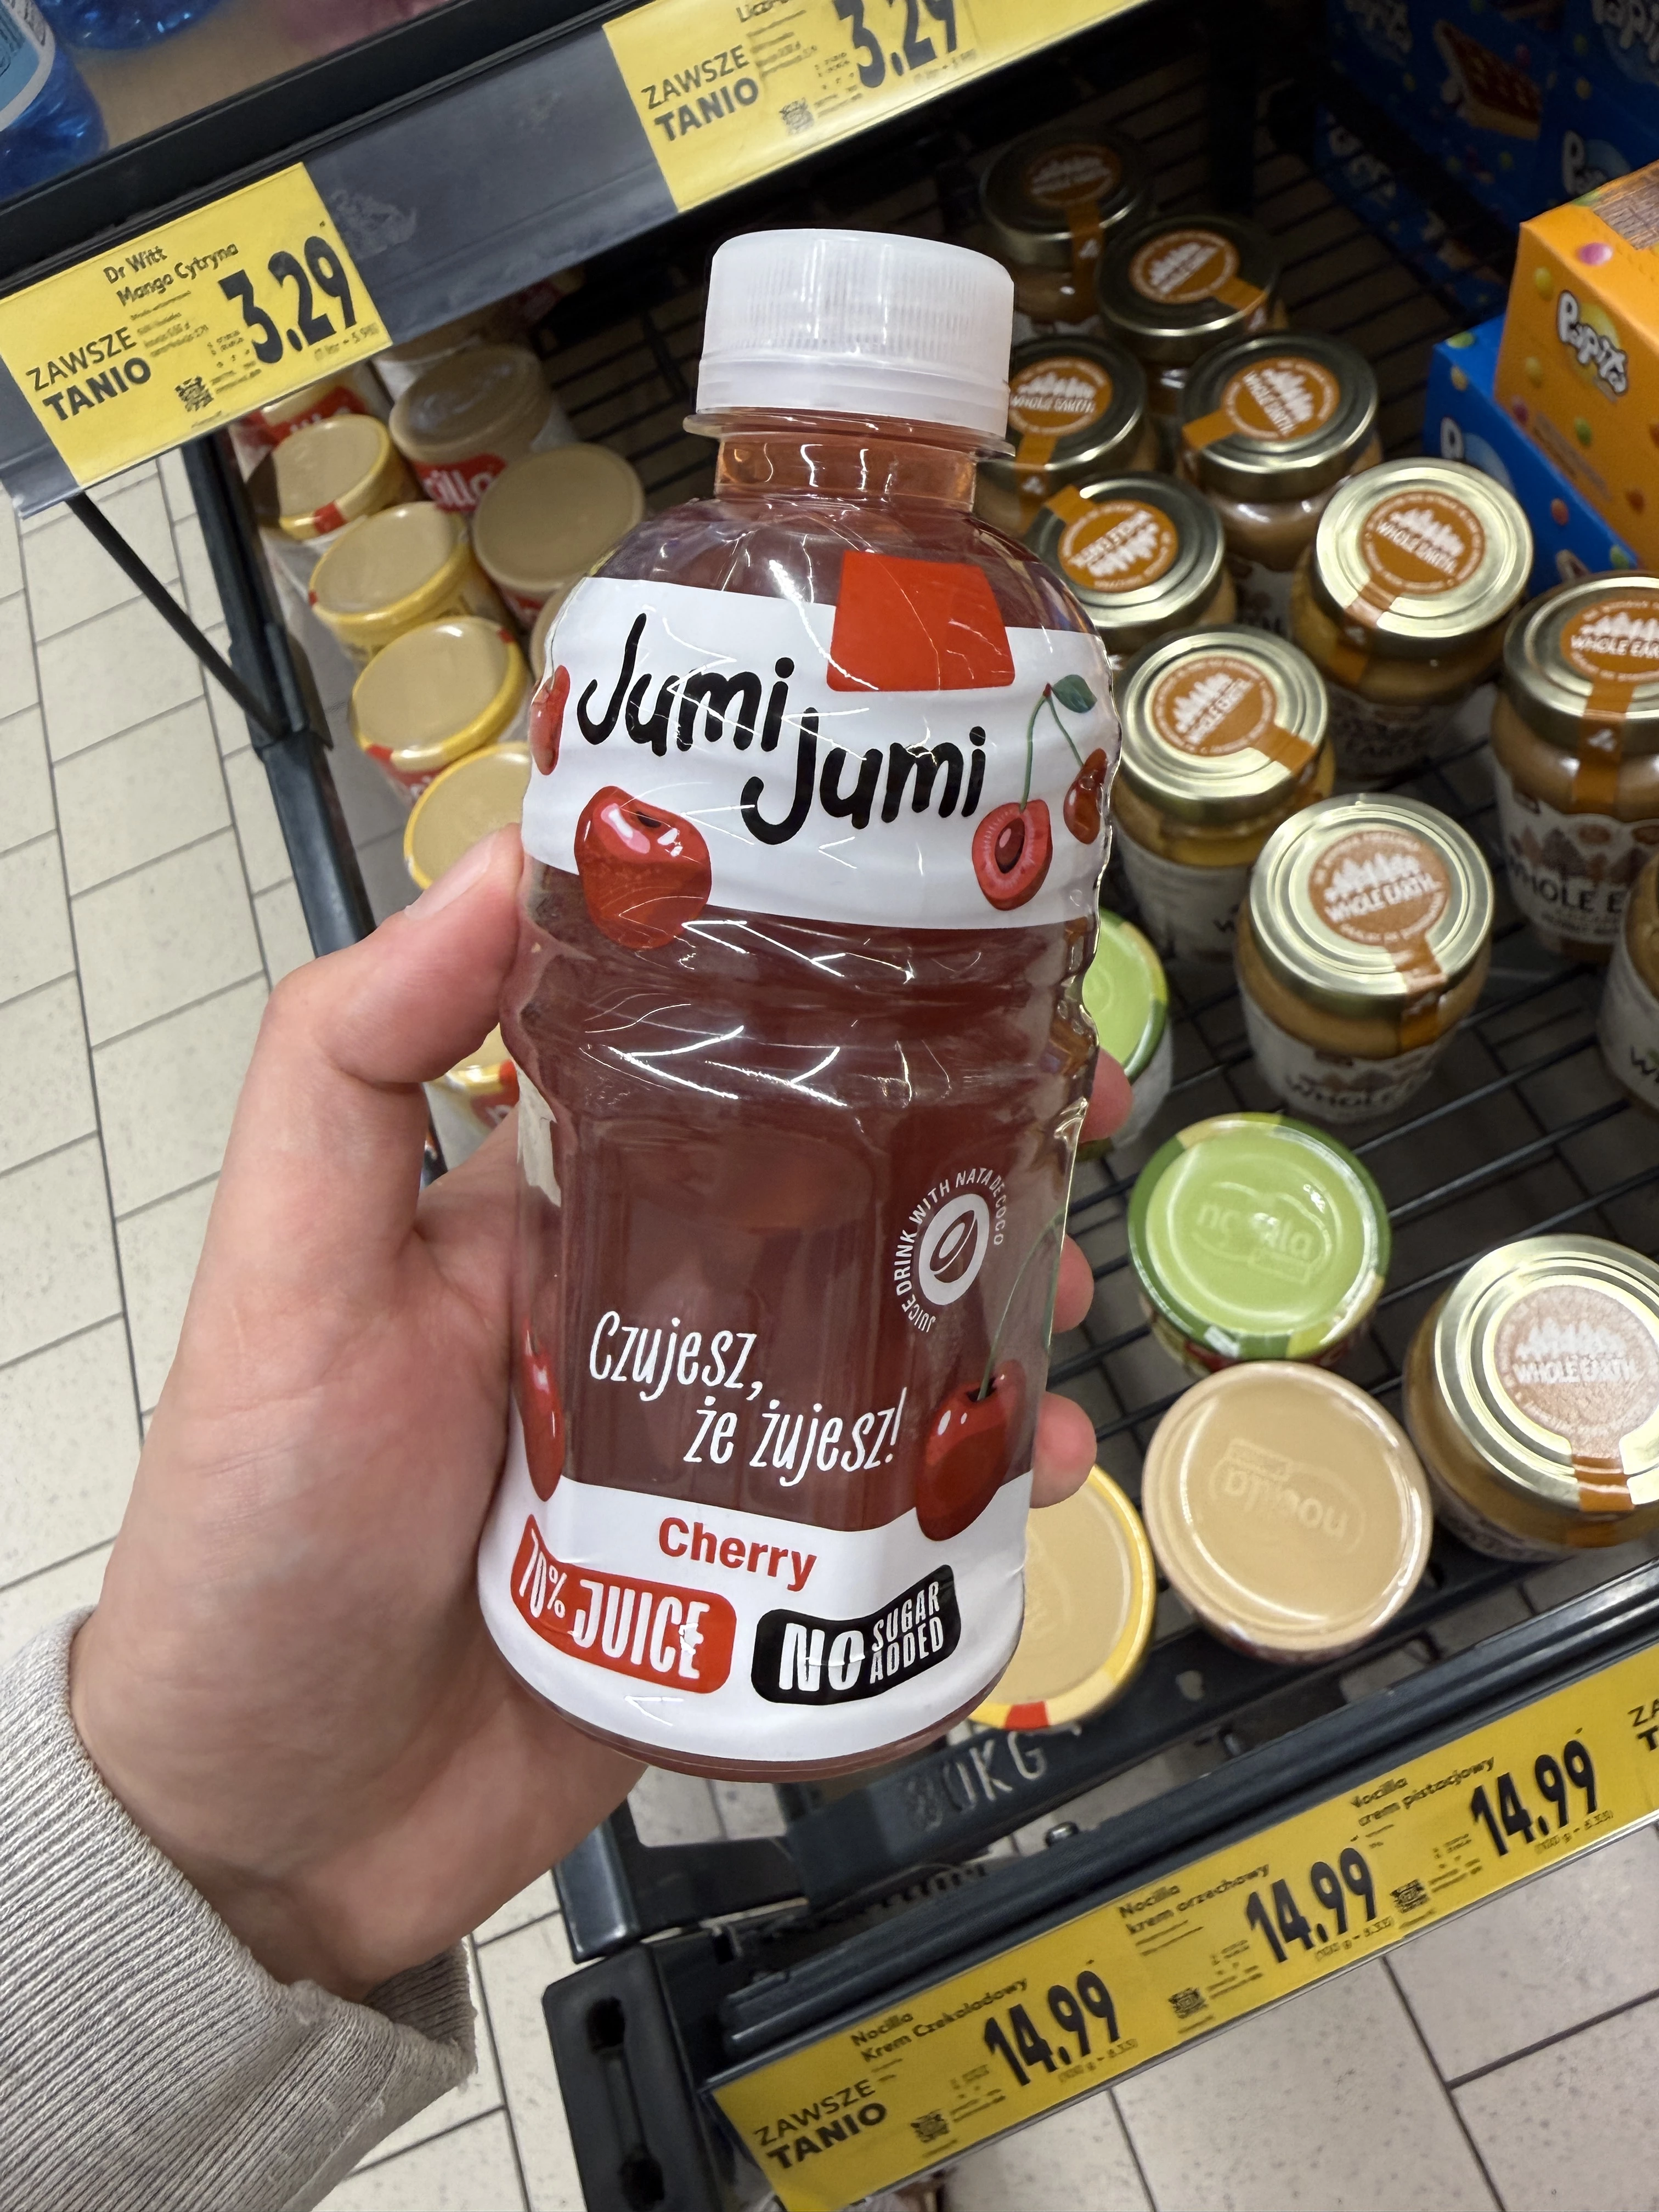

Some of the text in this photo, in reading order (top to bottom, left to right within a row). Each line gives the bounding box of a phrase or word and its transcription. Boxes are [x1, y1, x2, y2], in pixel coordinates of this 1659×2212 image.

[640, 43, 751, 110] ZAWSZE
[653, 76, 759, 143] TANIO
[103, 246, 168, 284] Dr Witt
[116, 273, 174, 307] Mango
[173, 243, 239, 280] Cytryna
[217, 235, 358, 365] 3.29
[26, 326, 137, 392] ZAWSZE
[42, 357, 152, 421] TANIO
[577, 613, 794, 757] Jumi
[894, 1167, 1007, 1333] JUICE DRINK WITH NATA DE COCO
[589, 1311, 764, 1402] Czujesz,
[682, 1387, 908, 1487] że żujesz!
[658, 1516, 818, 1592] Cherry
[573, 1578, 710, 1679] JUICE
[870, 1616, 944, 1684] ADDED
[872, 1581, 940, 1652] SUGAR
[778, 1623, 865, 1691] NO
[1470, 1739, 1597, 1858] 14.99
[1244, 1847, 1377, 1964] 14.99
[860, 1978, 1029, 2063] Krem Czekoladowy
[984, 1970, 1120, 2087] 14.99
[753, 2078, 876, 2147] ZAWSZE
[766, 2102, 888, 2170] TANIO
